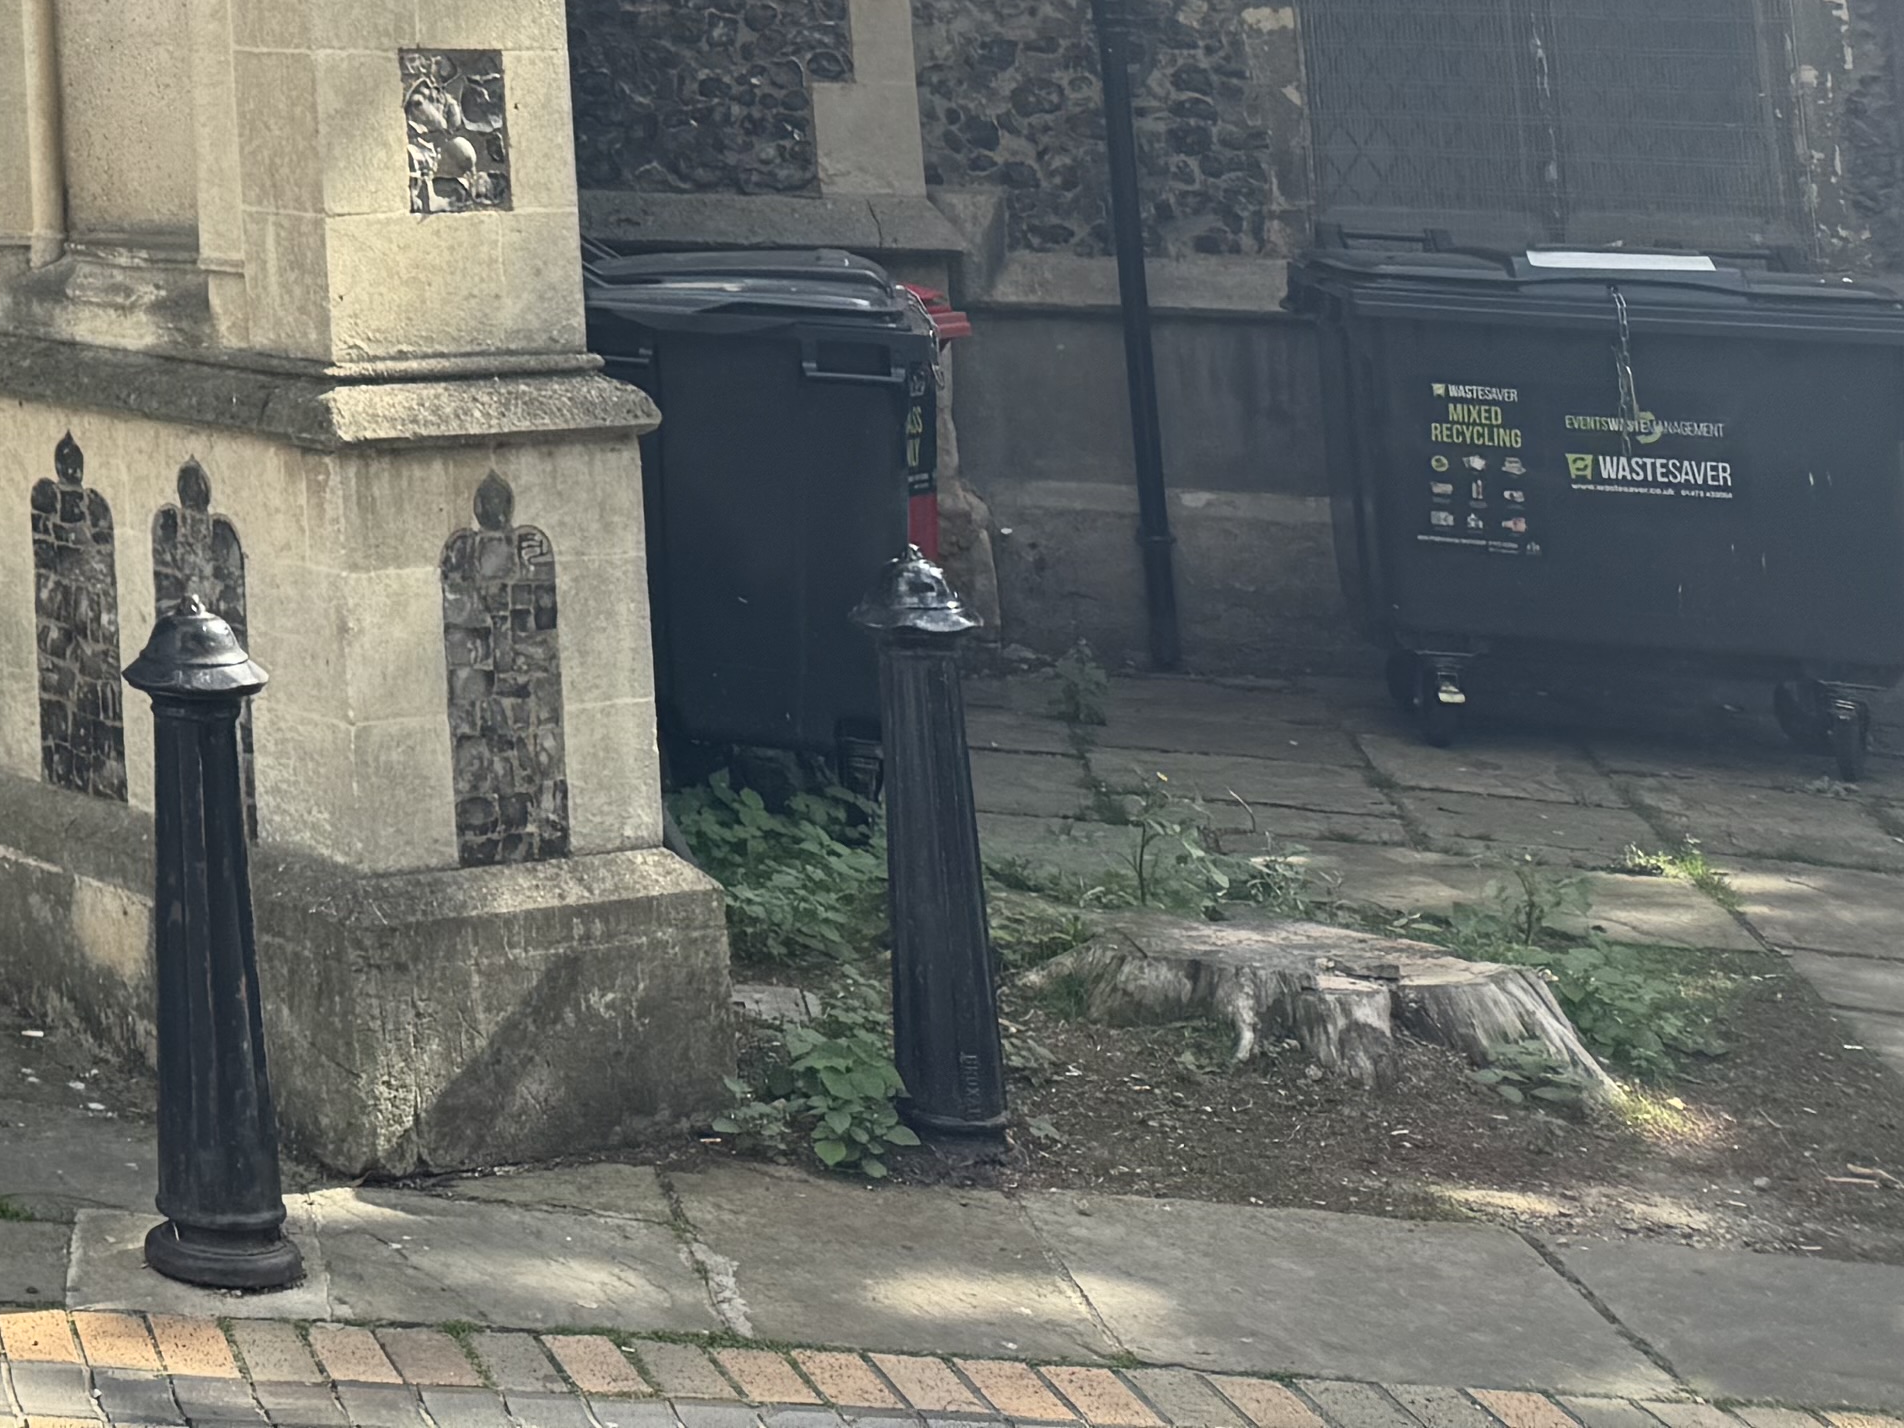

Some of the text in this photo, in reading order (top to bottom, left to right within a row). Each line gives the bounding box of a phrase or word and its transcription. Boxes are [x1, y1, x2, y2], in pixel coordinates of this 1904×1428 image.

[1448, 384, 1518, 402] WASTESAVER
[1448, 403, 1502, 425] MIXED
[1431, 423, 1522, 448] RECYCLING
[1599, 455, 1732, 486] WASTESAVER
